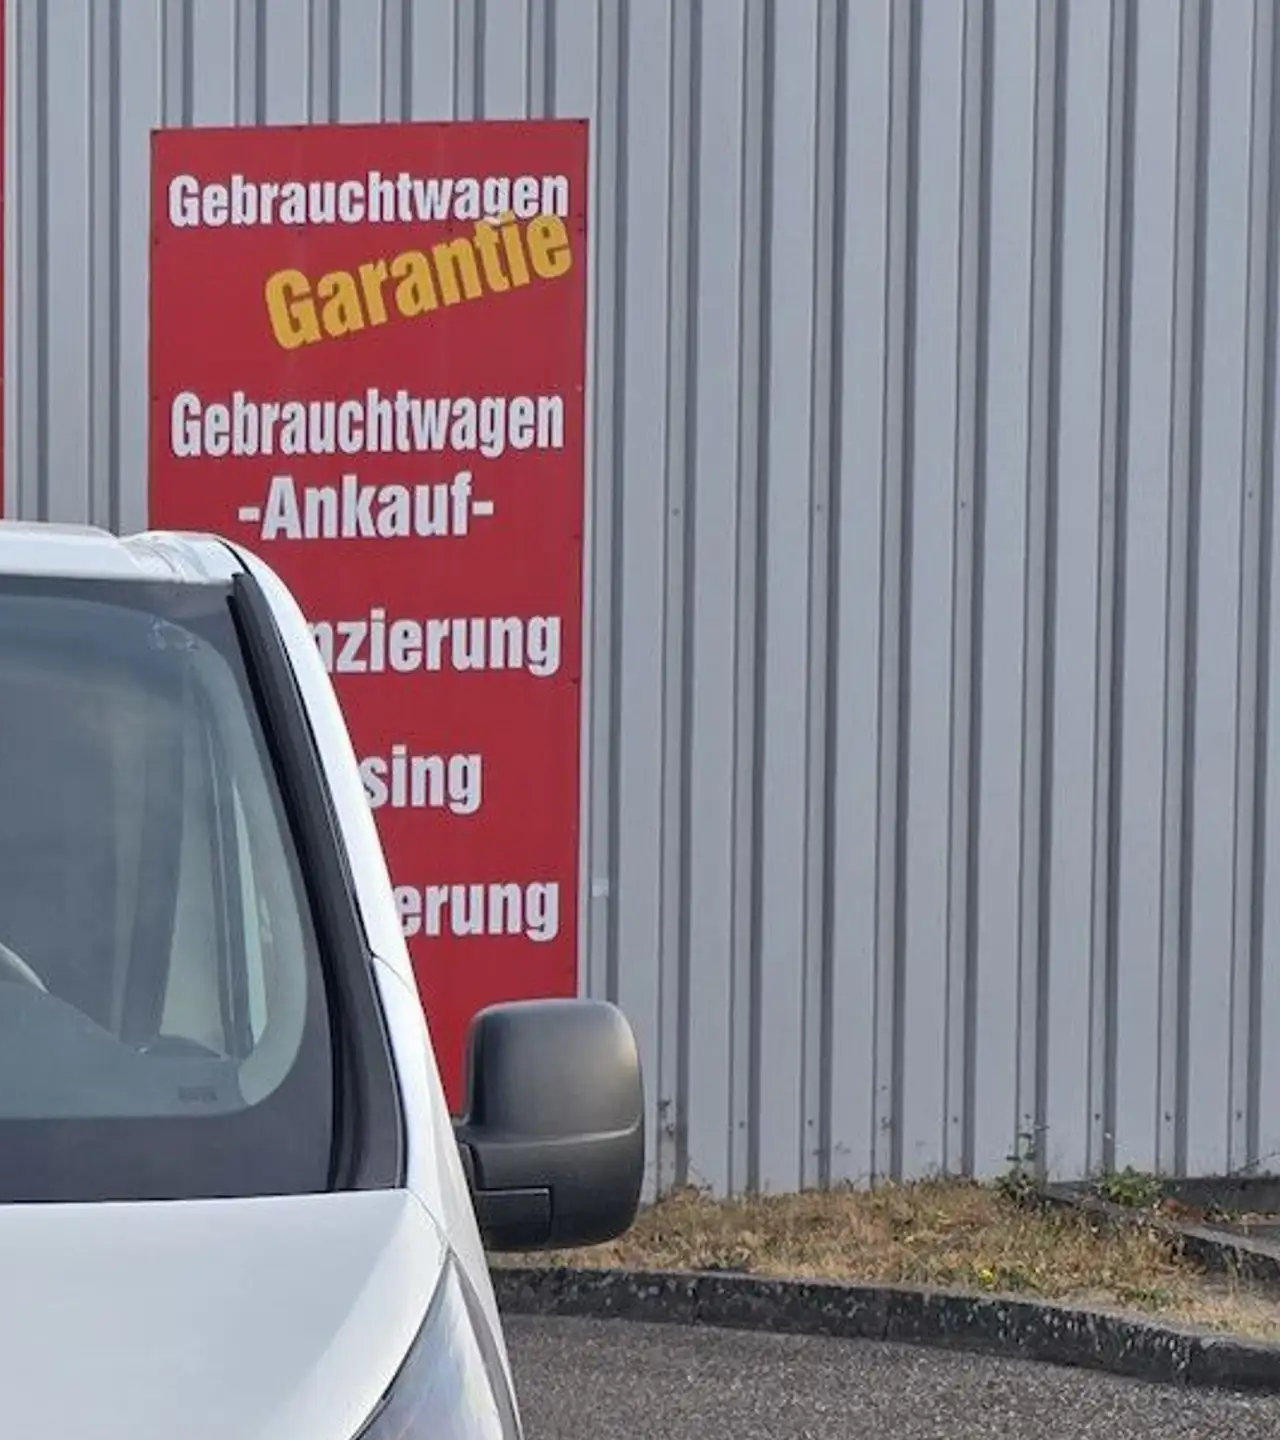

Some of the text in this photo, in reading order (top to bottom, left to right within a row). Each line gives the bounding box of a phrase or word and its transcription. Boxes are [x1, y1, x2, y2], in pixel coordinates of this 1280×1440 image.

[168, 171, 569, 227] Gebrauchtwagen
[263, 212, 572, 350] Garantie
[171, 388, 565, 458] Gebrauchtwagen
[238, 472, 495, 540] -Ankauf-
[306, 607, 561, 676] nzierung
[360, 744, 482, 814] sing
[394, 882, 559, 941] erung
